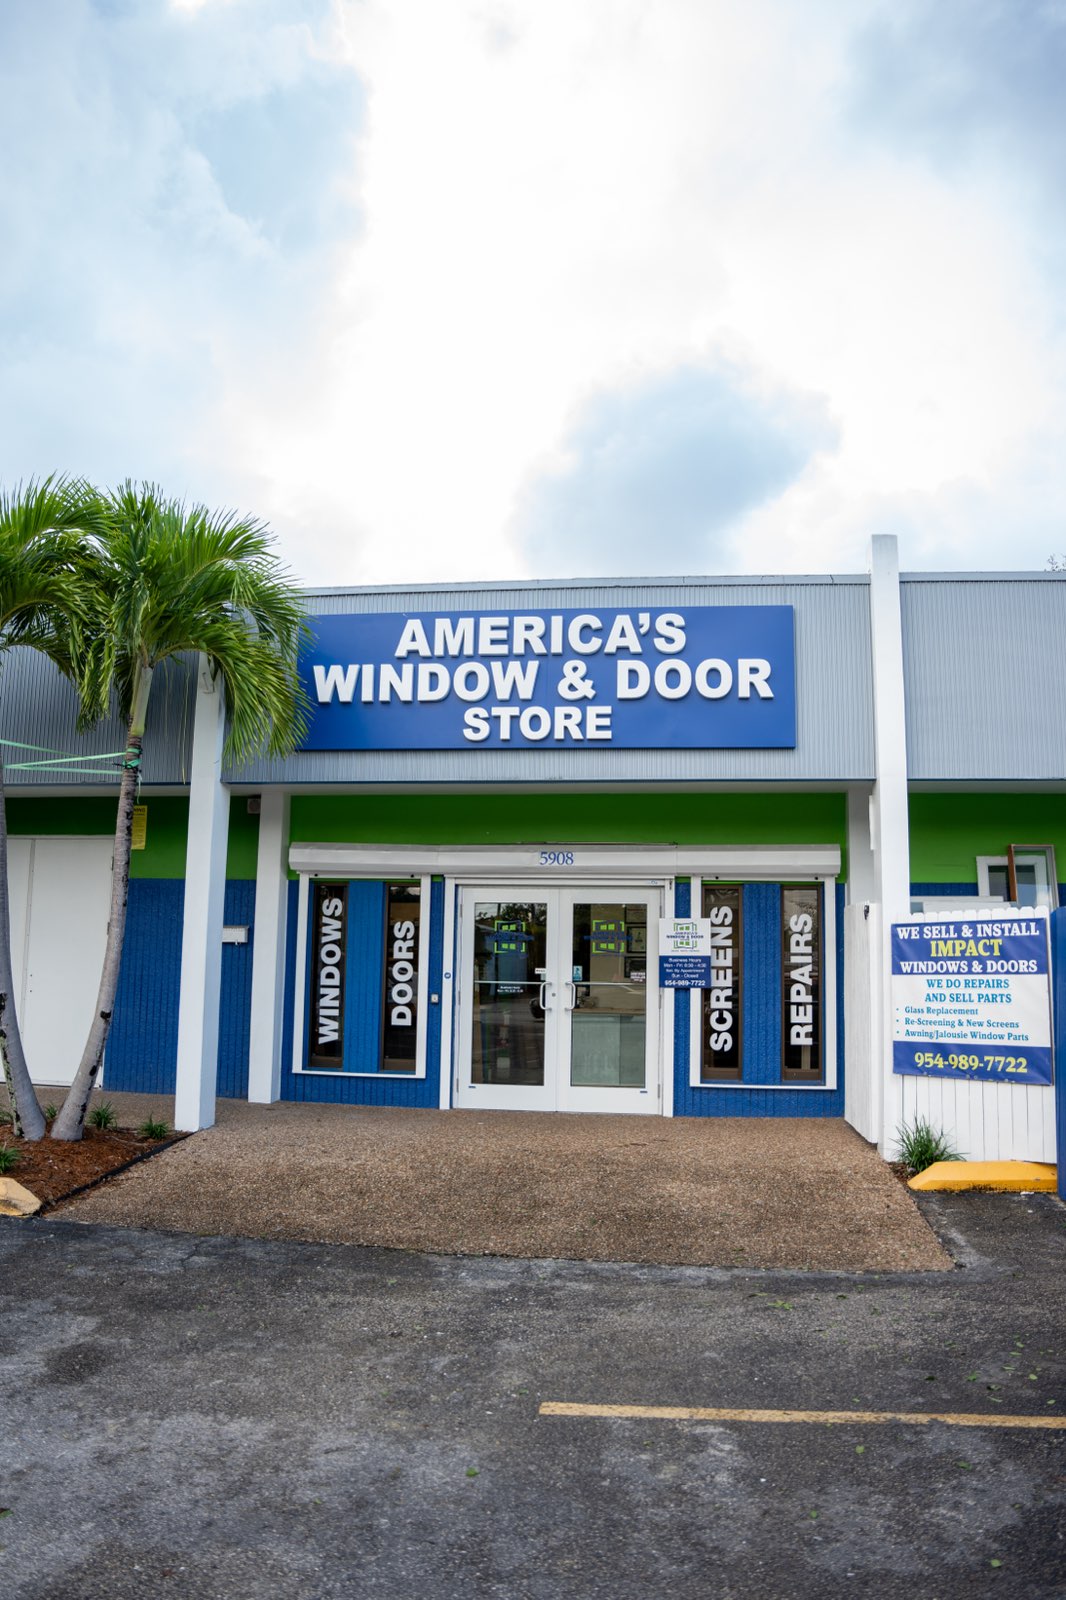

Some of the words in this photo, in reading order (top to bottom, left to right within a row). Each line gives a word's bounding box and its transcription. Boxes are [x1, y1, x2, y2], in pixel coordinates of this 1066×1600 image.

[394, 613, 687, 658] AMERICA'S
[313, 661, 540, 703] WINDOW
[557, 660, 597, 701] &
[616, 658, 774, 700] DOOR
[462, 705, 613, 742] STORE
[540, 851, 574, 866] 5908
[897, 926, 920, 939] WE
[923, 925, 958, 939] SELL
[961, 924, 973, 938] &
[976, 922, 1040, 937] INSTALL
[930, 939, 1002, 957] IMPACT
[318, 897, 343, 1045] WINDOWS
[391, 920, 415, 1026] DOORS
[900, 961, 968, 973] WINDOWS
[972, 960, 983, 973] &
[986, 960, 1038, 973] DOORS
[709, 905, 733, 1052] SCREENS
[790, 913, 813, 1046] REPAIRS
[926, 979, 943, 988] WE
[946, 979, 961, 988] DO
[964, 979, 1010, 988] REPAIRS
[925, 993, 946, 1002] AND
[949, 993, 974, 1002] SELL
[977, 993, 1012, 1003] PARTS
[904, 1006, 924, 1014] Glass
[926, 1006, 979, 1016] Replacement
[904, 1018, 956, 1028] Re-Screening
[957, 1018, 964, 1026] &
[966, 1019, 984, 1027] New
[986, 1020, 1019, 1028] Screens
[970, 1031, 1006, 1040] Window
[1007, 1032, 1029, 1041] Parts
[914, 1052, 1028, 1073] 954-989-7722
